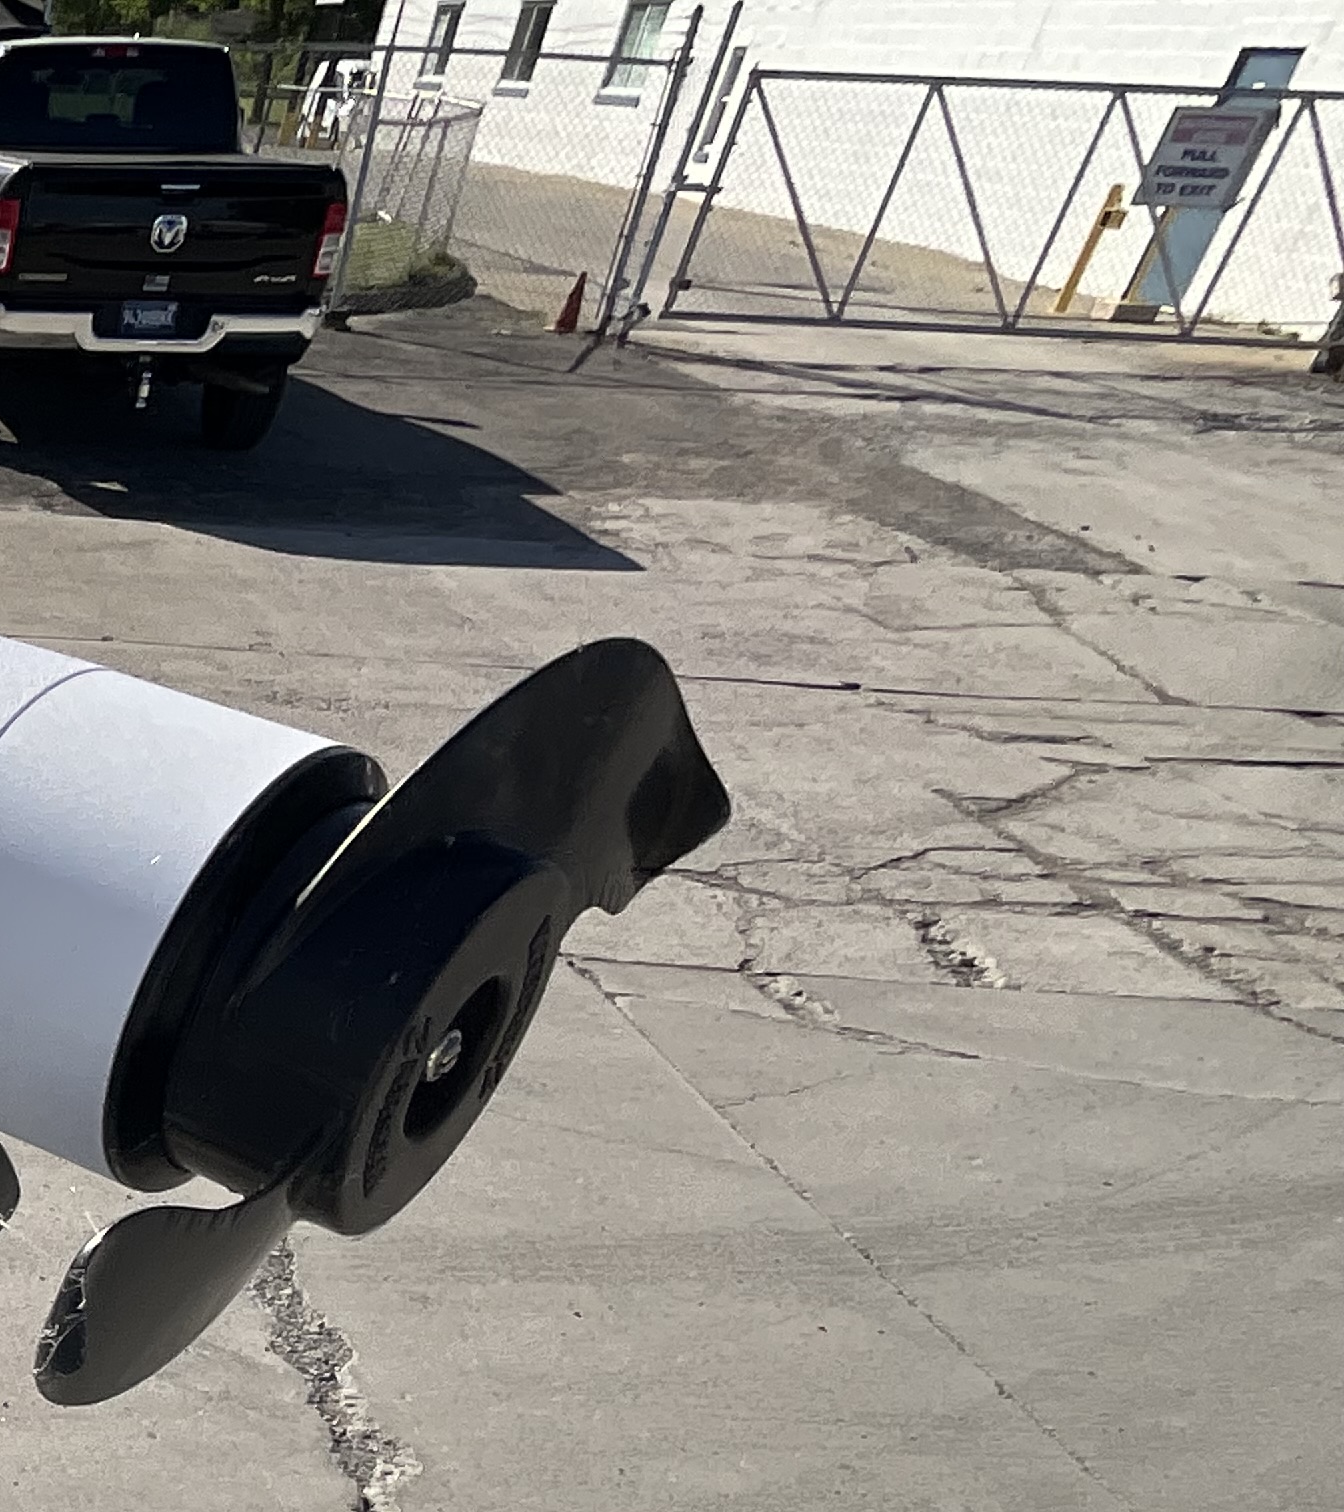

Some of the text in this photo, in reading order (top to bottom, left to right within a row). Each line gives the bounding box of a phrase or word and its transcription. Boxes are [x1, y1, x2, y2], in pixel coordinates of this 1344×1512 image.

[1180, 148, 1217, 162] PULL
[1155, 164, 1229, 179] FORWARD
[1155, 182, 1217, 197] TO EXIT
